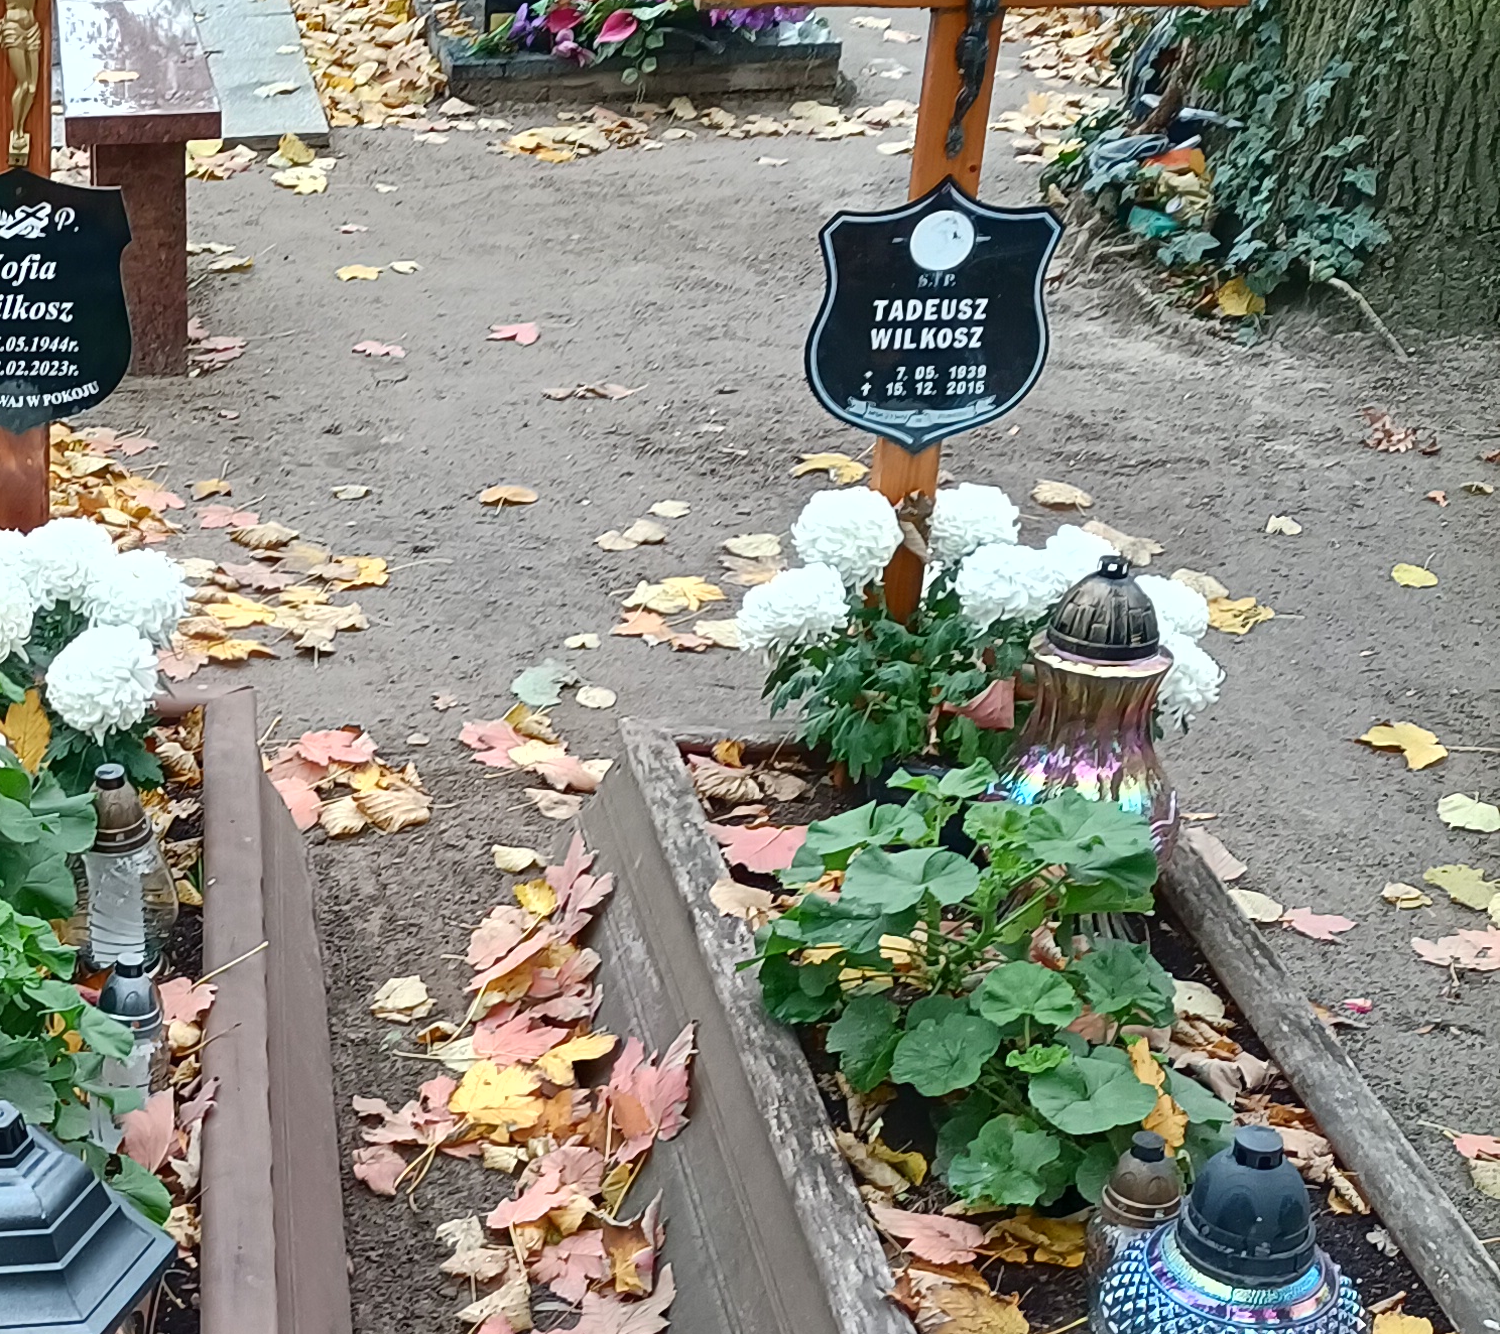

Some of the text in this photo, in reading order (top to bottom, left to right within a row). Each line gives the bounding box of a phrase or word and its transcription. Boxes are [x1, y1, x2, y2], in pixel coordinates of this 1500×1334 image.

[872, 297, 989, 322] TADEUSZ
[870, 326, 985, 351] WILKOSZ
[26, 394, 41, 408] W
[43, 380, 100, 407] POKOJU
